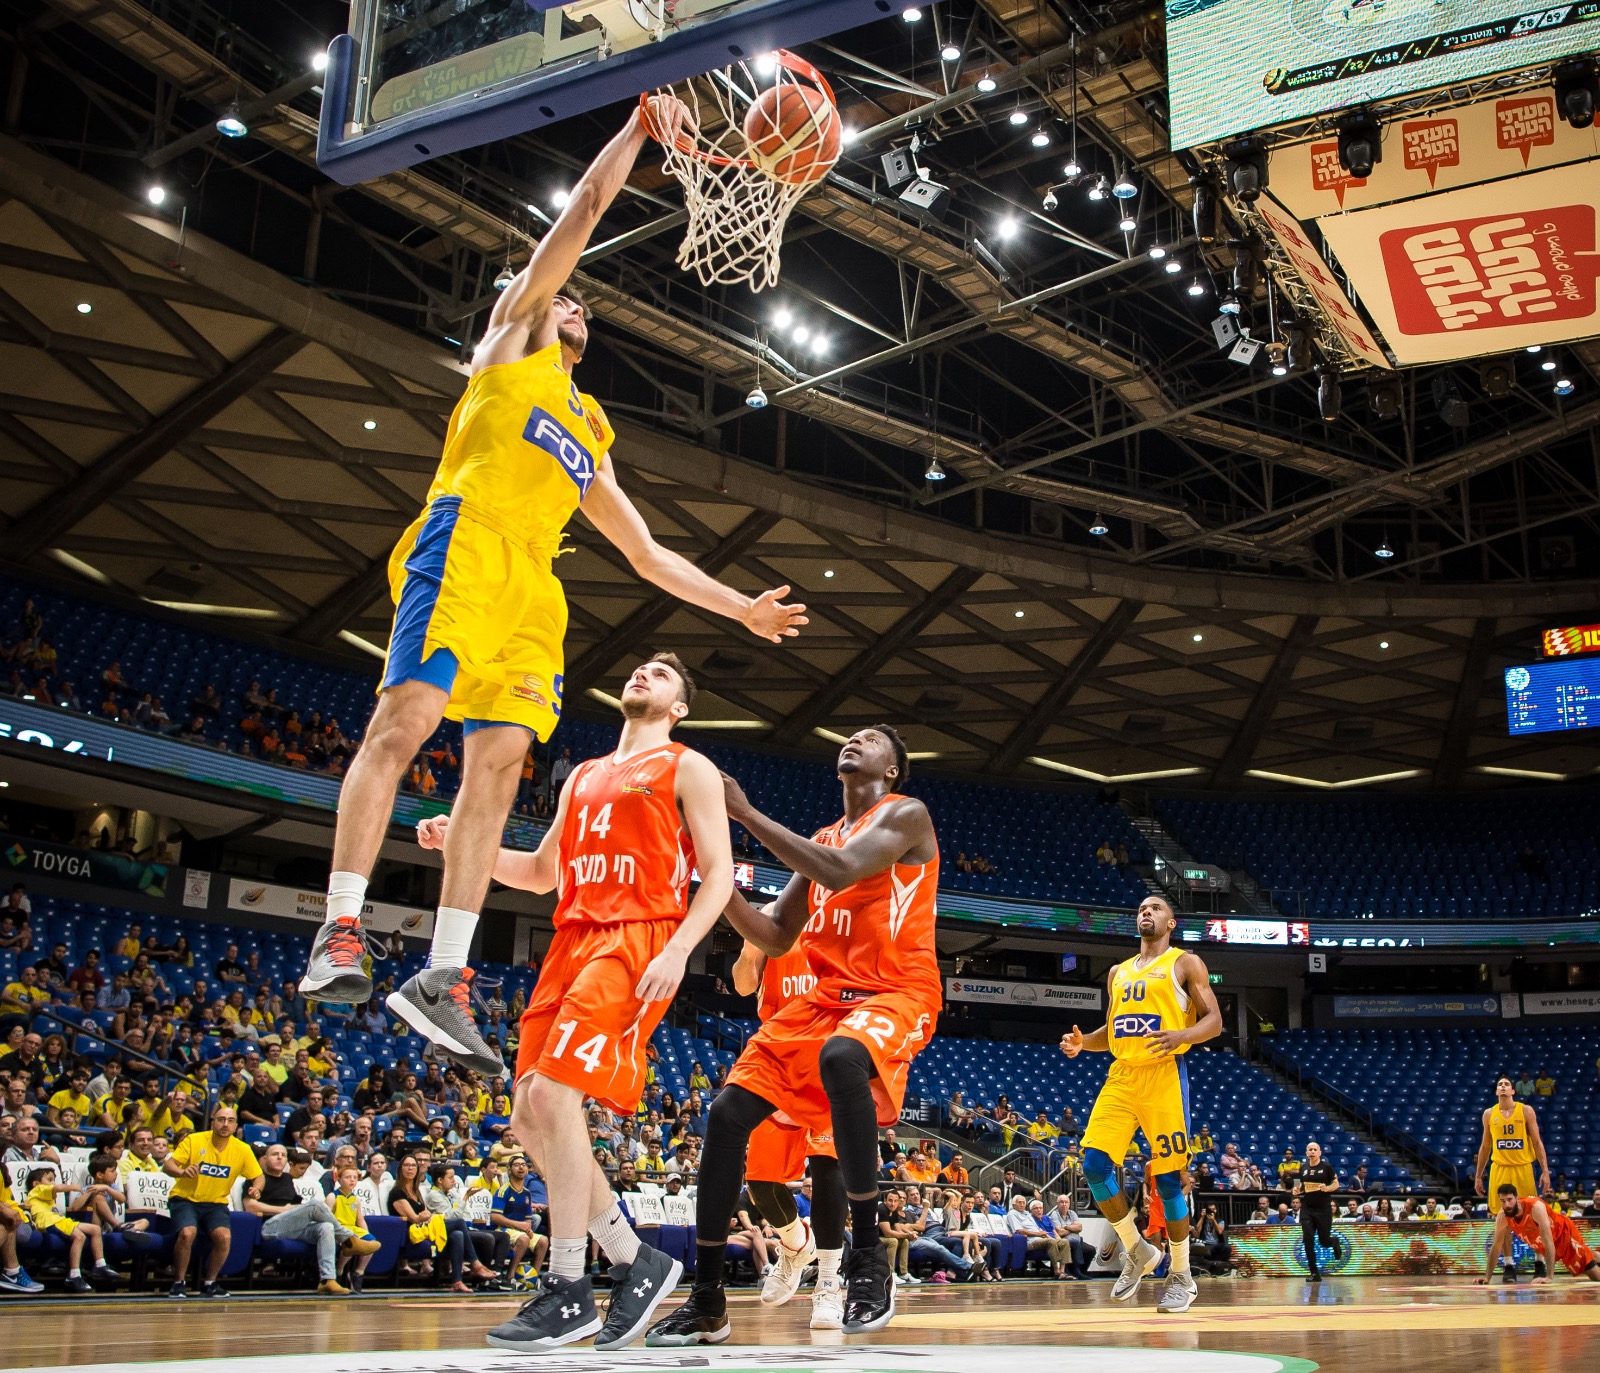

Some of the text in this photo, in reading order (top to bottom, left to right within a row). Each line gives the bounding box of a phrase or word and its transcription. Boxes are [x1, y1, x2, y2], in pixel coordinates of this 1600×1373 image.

[1498, 102, 1551, 124] מעדני
[1404, 124, 1456, 145] מעדני
[1502, 117, 1552, 140] הטלה
[1409, 139, 1457, 160] הטלה
[1469, 217, 1558, 318] הטלה
[1403, 227, 1493, 330] מעדני
[534, 418, 593, 495] FOX
[577, 802, 613, 842] 14
[33, 850, 91, 878] TOYGA
[613, 854, 636, 885] חי
[296, 906, 329, 919] Menor
[832, 907, 852, 937] חי
[1208, 921, 1226, 941] 4
[1291, 923, 1304, 943] 5
[1313, 957, 1322, 969] 5
[963, 984, 1005, 995] SUZUKI
[1044, 988, 1097, 1001] BRIDGESTONE
[1122, 980, 1146, 1002] 30
[843, 1010, 896, 1050] 42
[1114, 1017, 1157, 1036] FOX
[552, 1019, 608, 1073] 14
[1502, 1124, 1514, 1135] 18
[1156, 1131, 1187, 1158] 30
[1498, 1140, 1522, 1149] FOX
[200, 1165, 229, 1177] FOX
[138, 1176, 171, 1196] greg
[669, 1201, 687, 1215] greg
